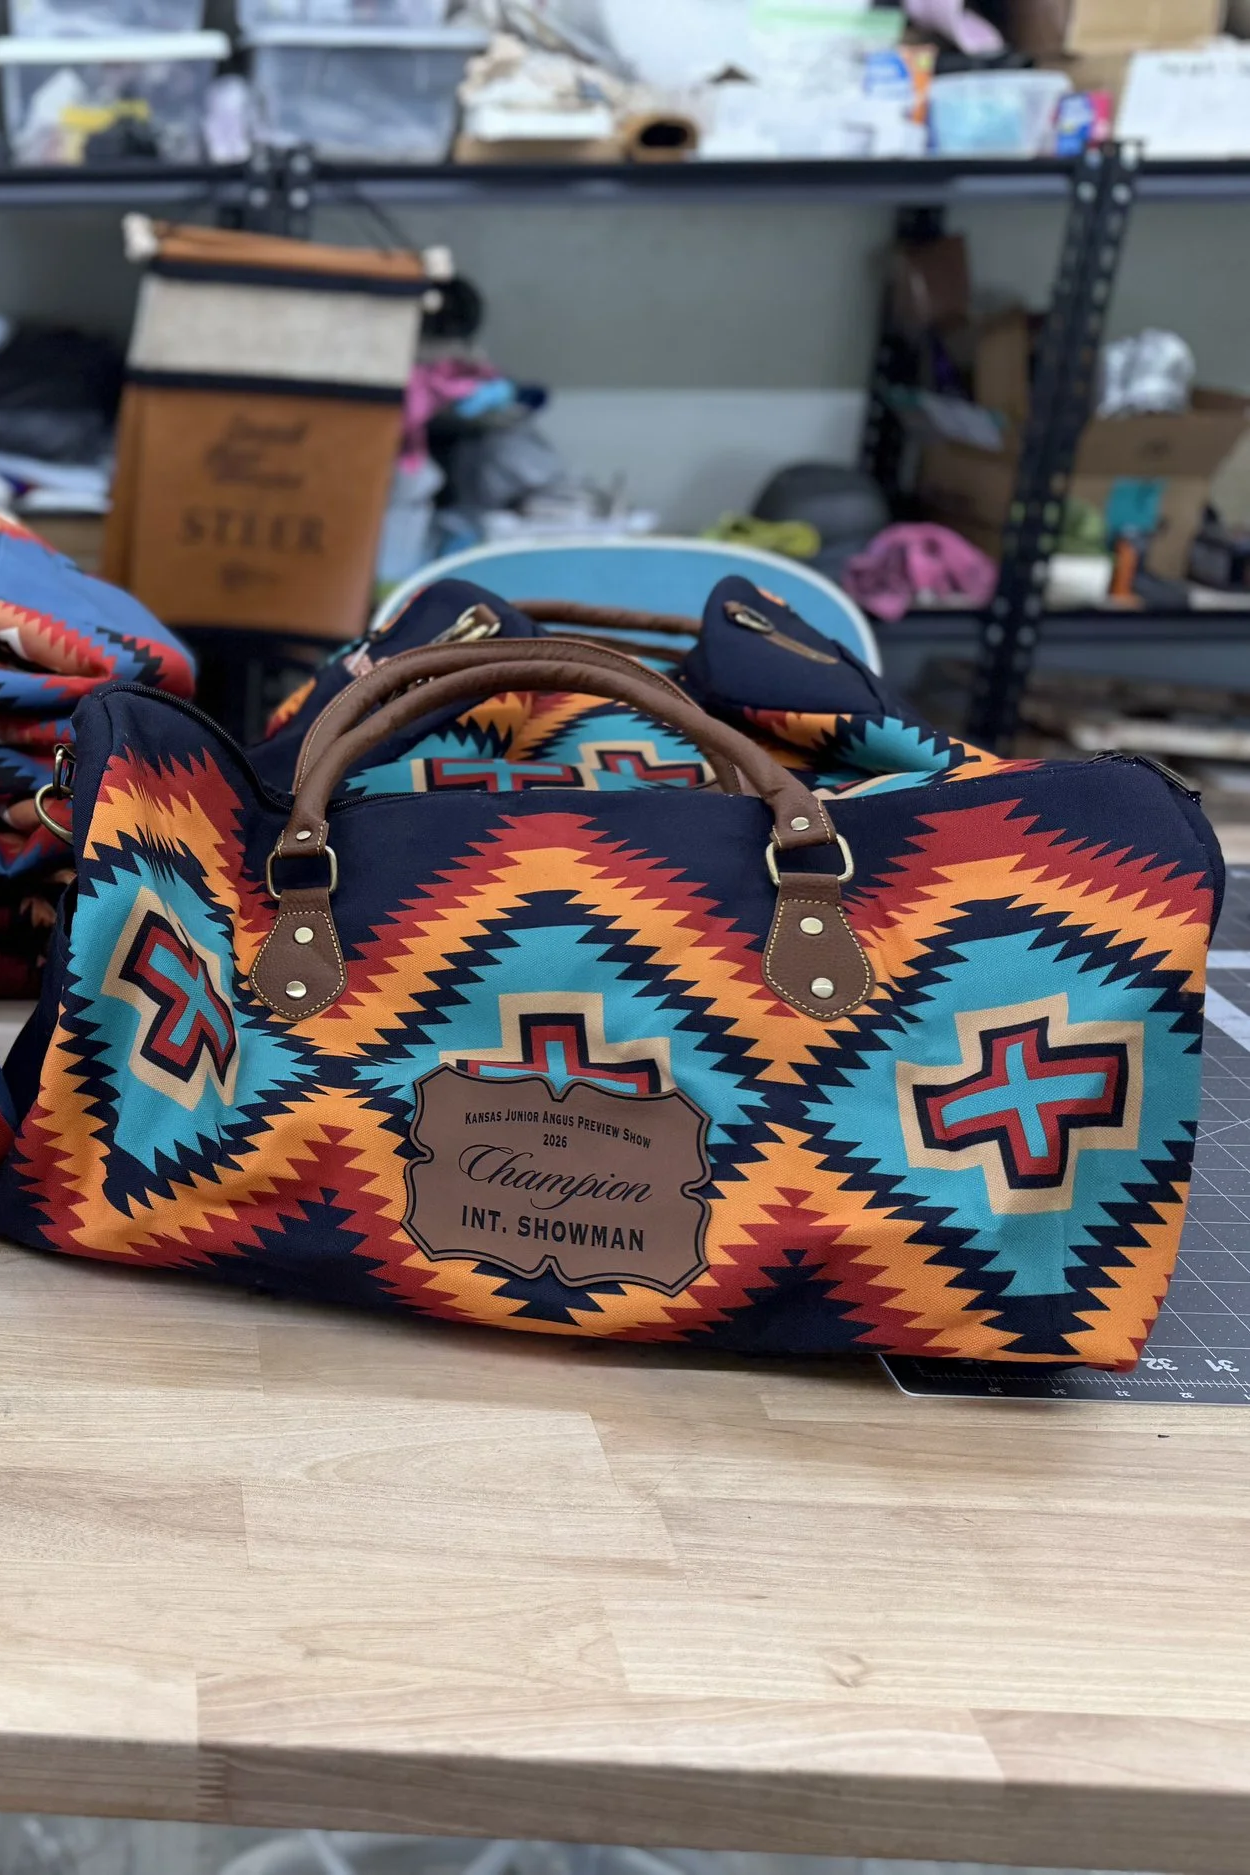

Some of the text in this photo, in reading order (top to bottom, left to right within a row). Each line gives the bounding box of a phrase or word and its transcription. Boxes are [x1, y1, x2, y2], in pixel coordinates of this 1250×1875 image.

[464, 1108, 651, 1149] KANSAS JUNIOR ANGUS PREVIEW SHOW
[543, 1133, 568, 1149] 2026
[458, 1144, 653, 1210] Champion
[461, 1205, 645, 1252] INT. SHOWMAN
[1140, 1357, 1240, 1373] 31 32
